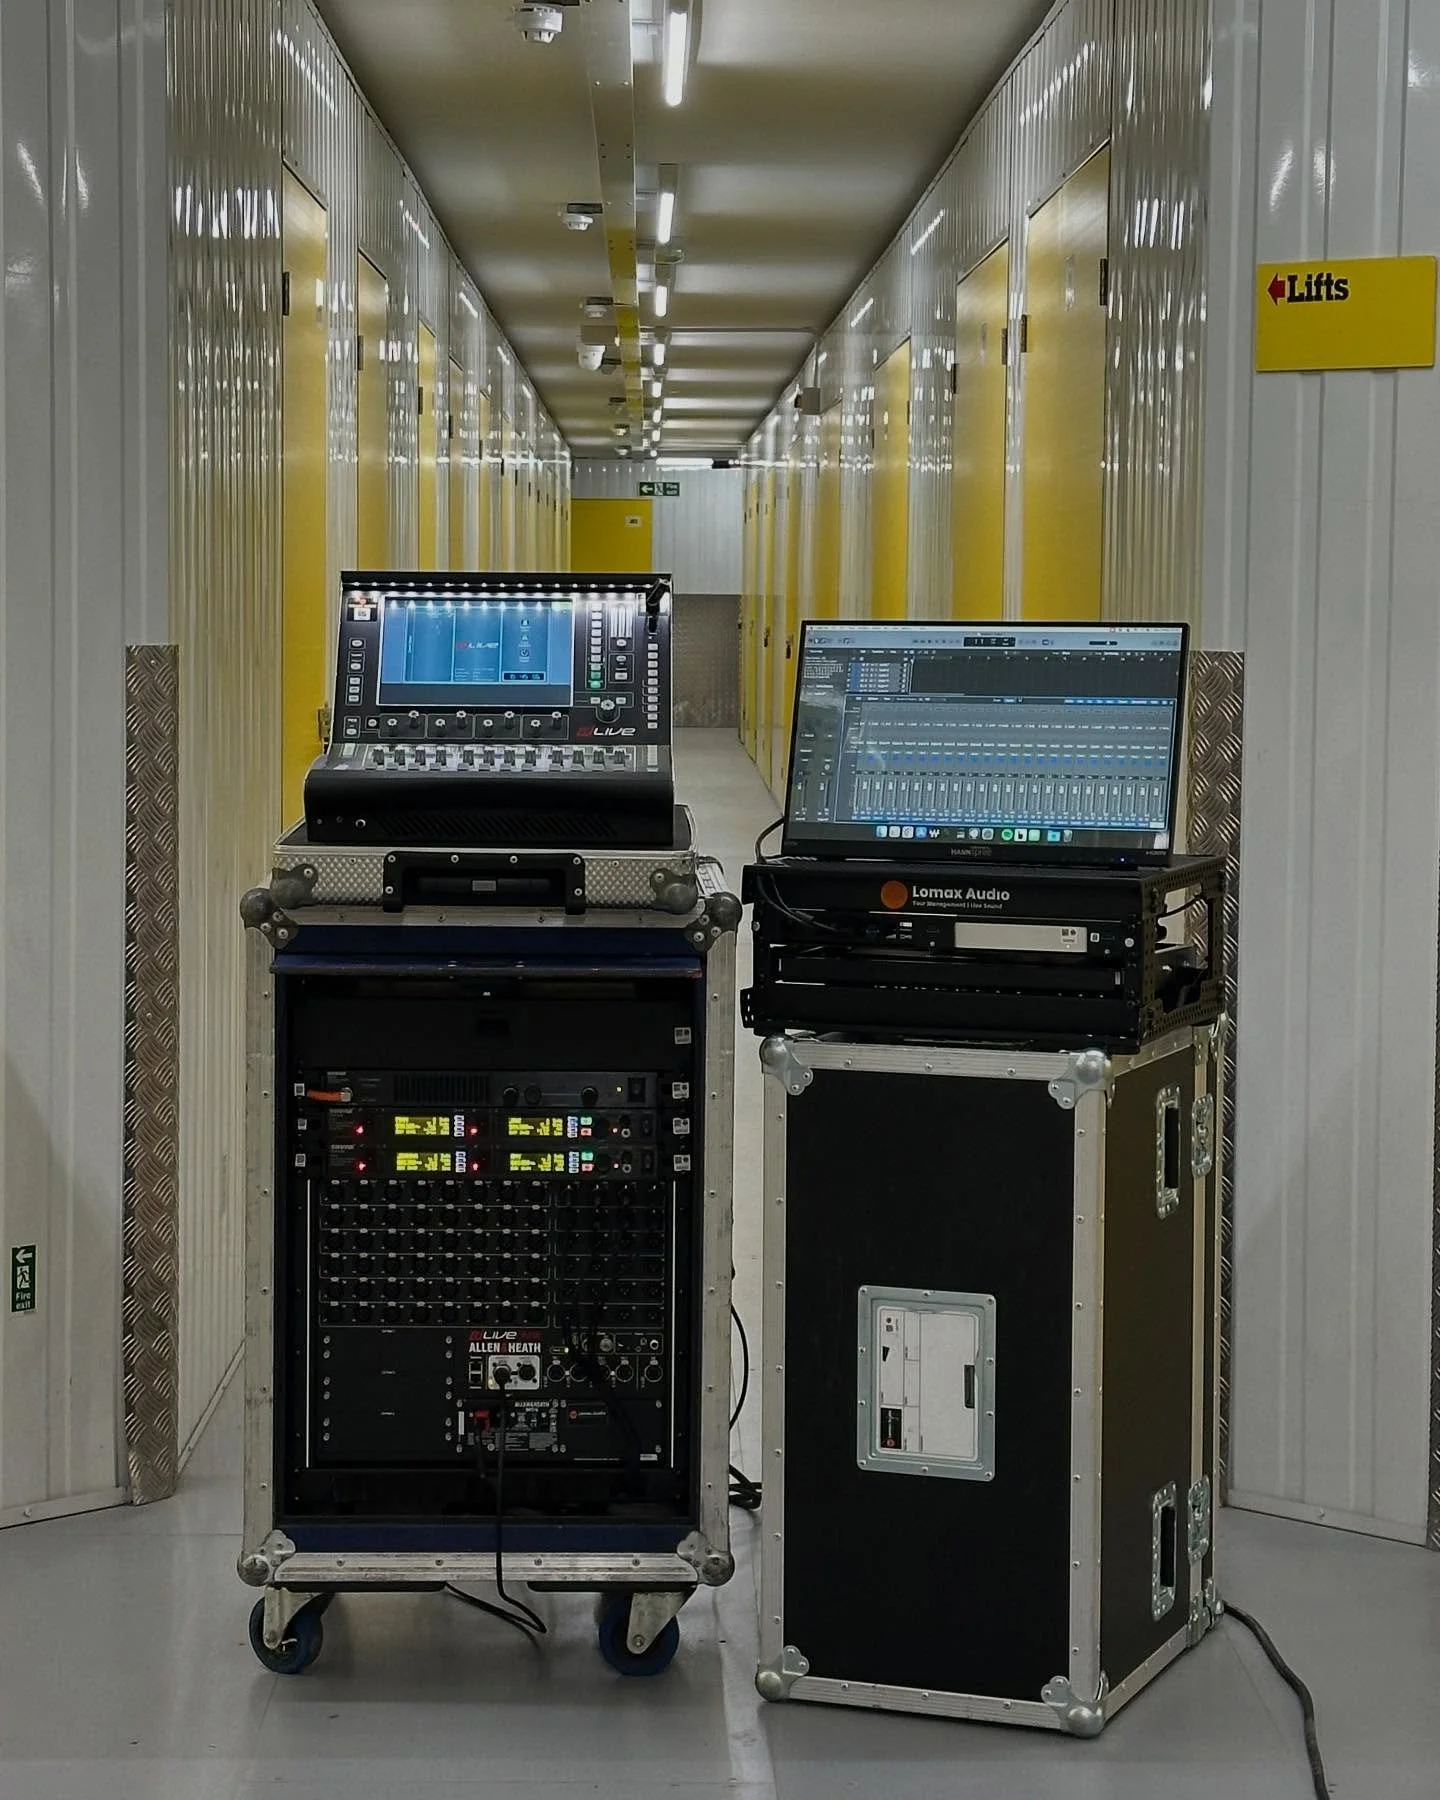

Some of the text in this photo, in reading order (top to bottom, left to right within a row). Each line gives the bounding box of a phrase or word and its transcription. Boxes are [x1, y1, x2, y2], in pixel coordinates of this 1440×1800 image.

[1287, 272, 1350, 303] Lifts
[912, 885, 1010, 901] Lomax Audio
[15, 1292, 31, 1301] Fire
[15, 1301, 31, 1310] exit
